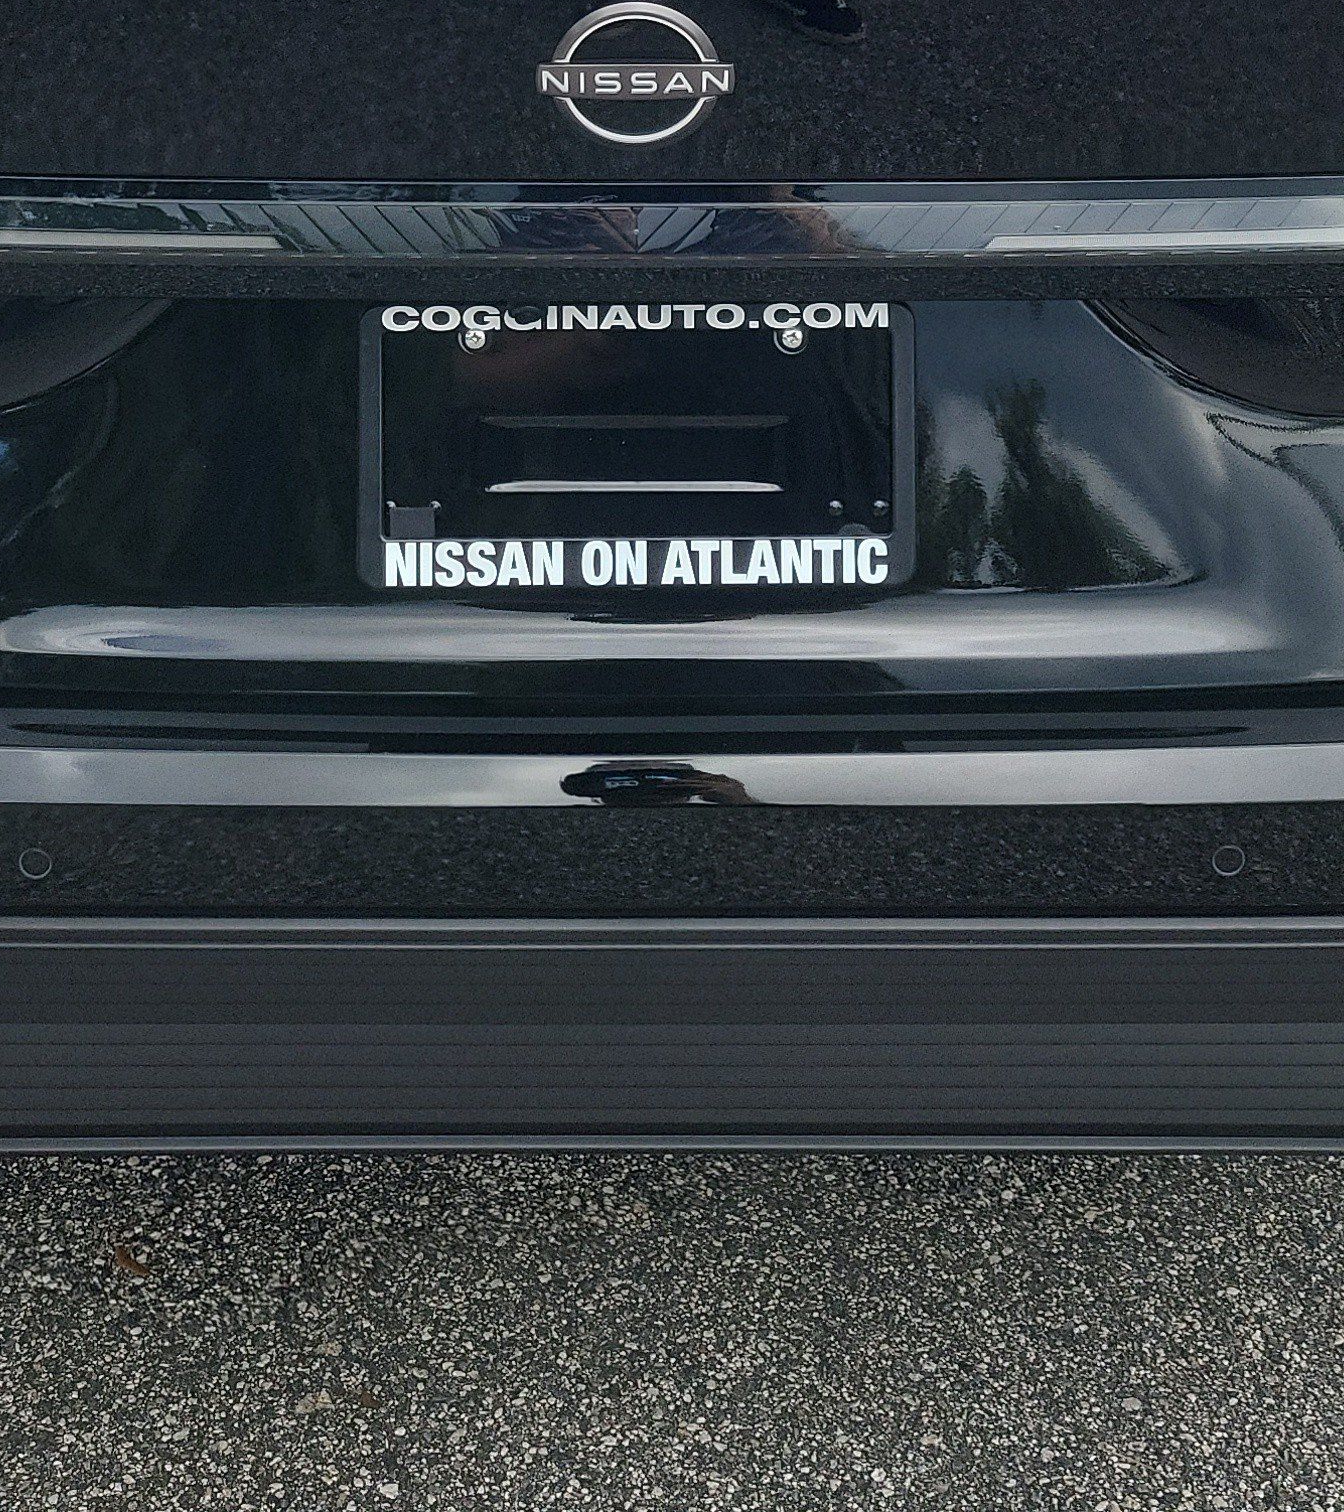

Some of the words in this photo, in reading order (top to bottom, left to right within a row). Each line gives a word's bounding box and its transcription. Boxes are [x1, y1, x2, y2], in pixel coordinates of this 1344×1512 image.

[541, 70, 729, 95] NISSAN
[385, 540, 566, 587] NISSAN
[581, 540, 647, 587] ON
[662, 538, 888, 585] ATLANTIC
